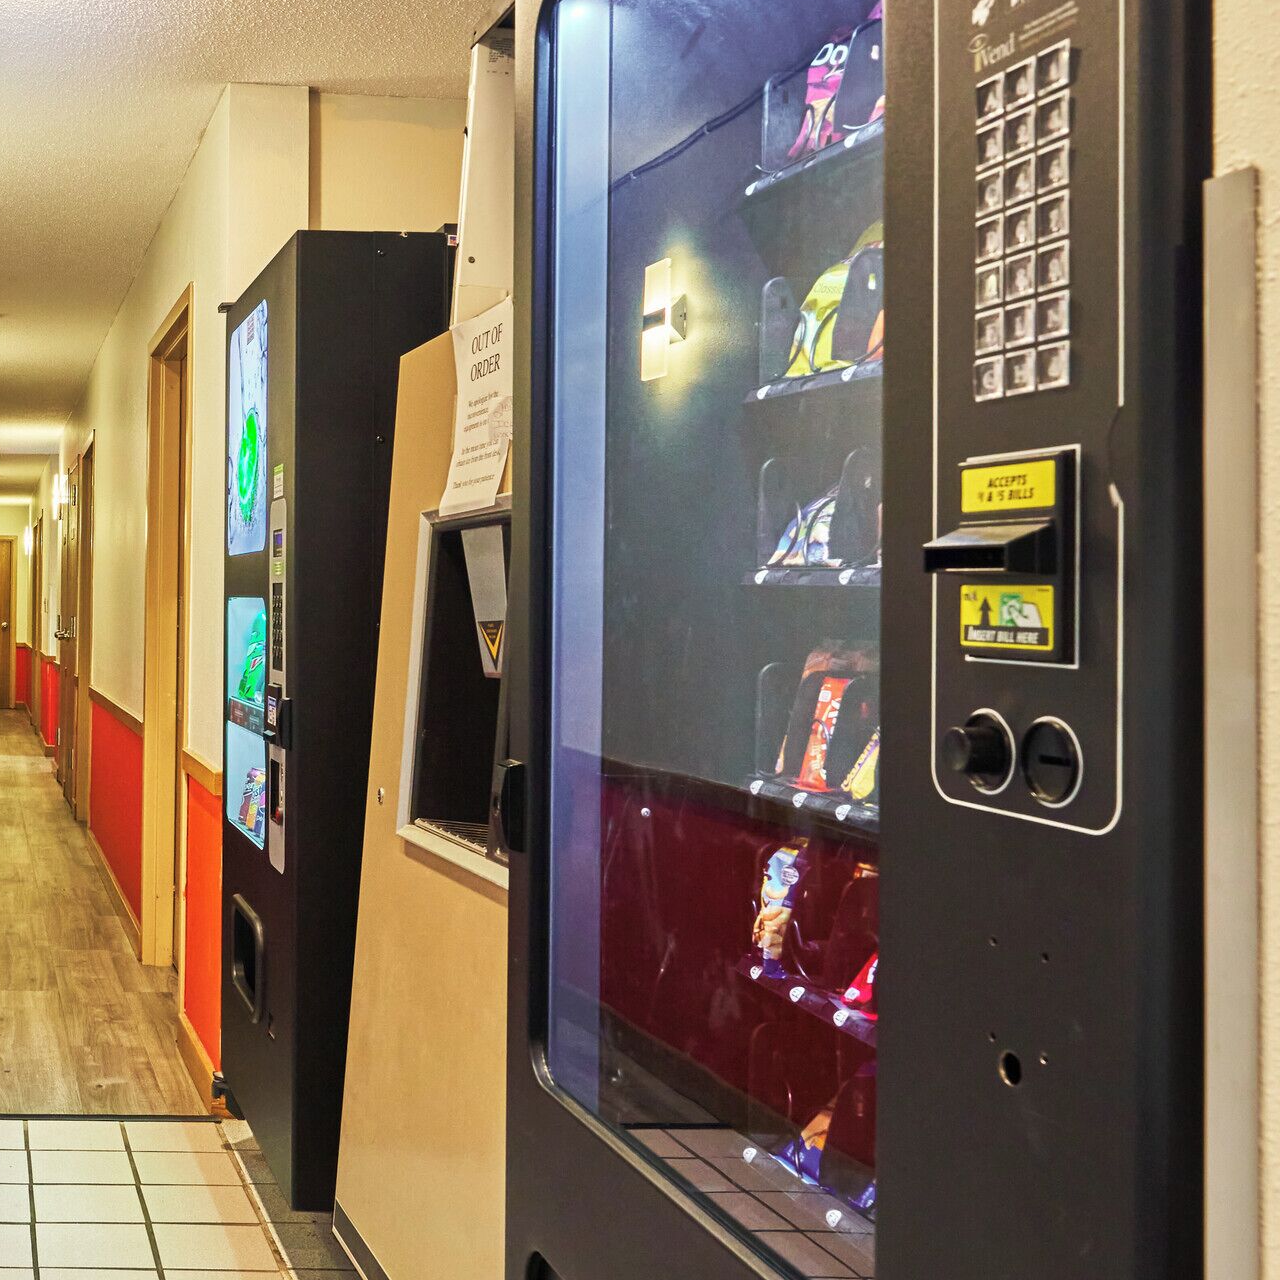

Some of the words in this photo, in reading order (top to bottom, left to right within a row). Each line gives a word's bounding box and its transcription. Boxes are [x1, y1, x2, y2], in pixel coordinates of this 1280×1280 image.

[471, 330, 490, 355] OUT
[491, 323, 503, 345] OF
[470, 353, 501, 381] ORDER
[987, 474, 1027, 488] ACCEPTS
[1007, 488, 1035, 501] BILLS
[966, 625, 997, 642] INSERT
[996, 629, 1015, 643] BILL
[1016, 630, 1039, 644] HERE
